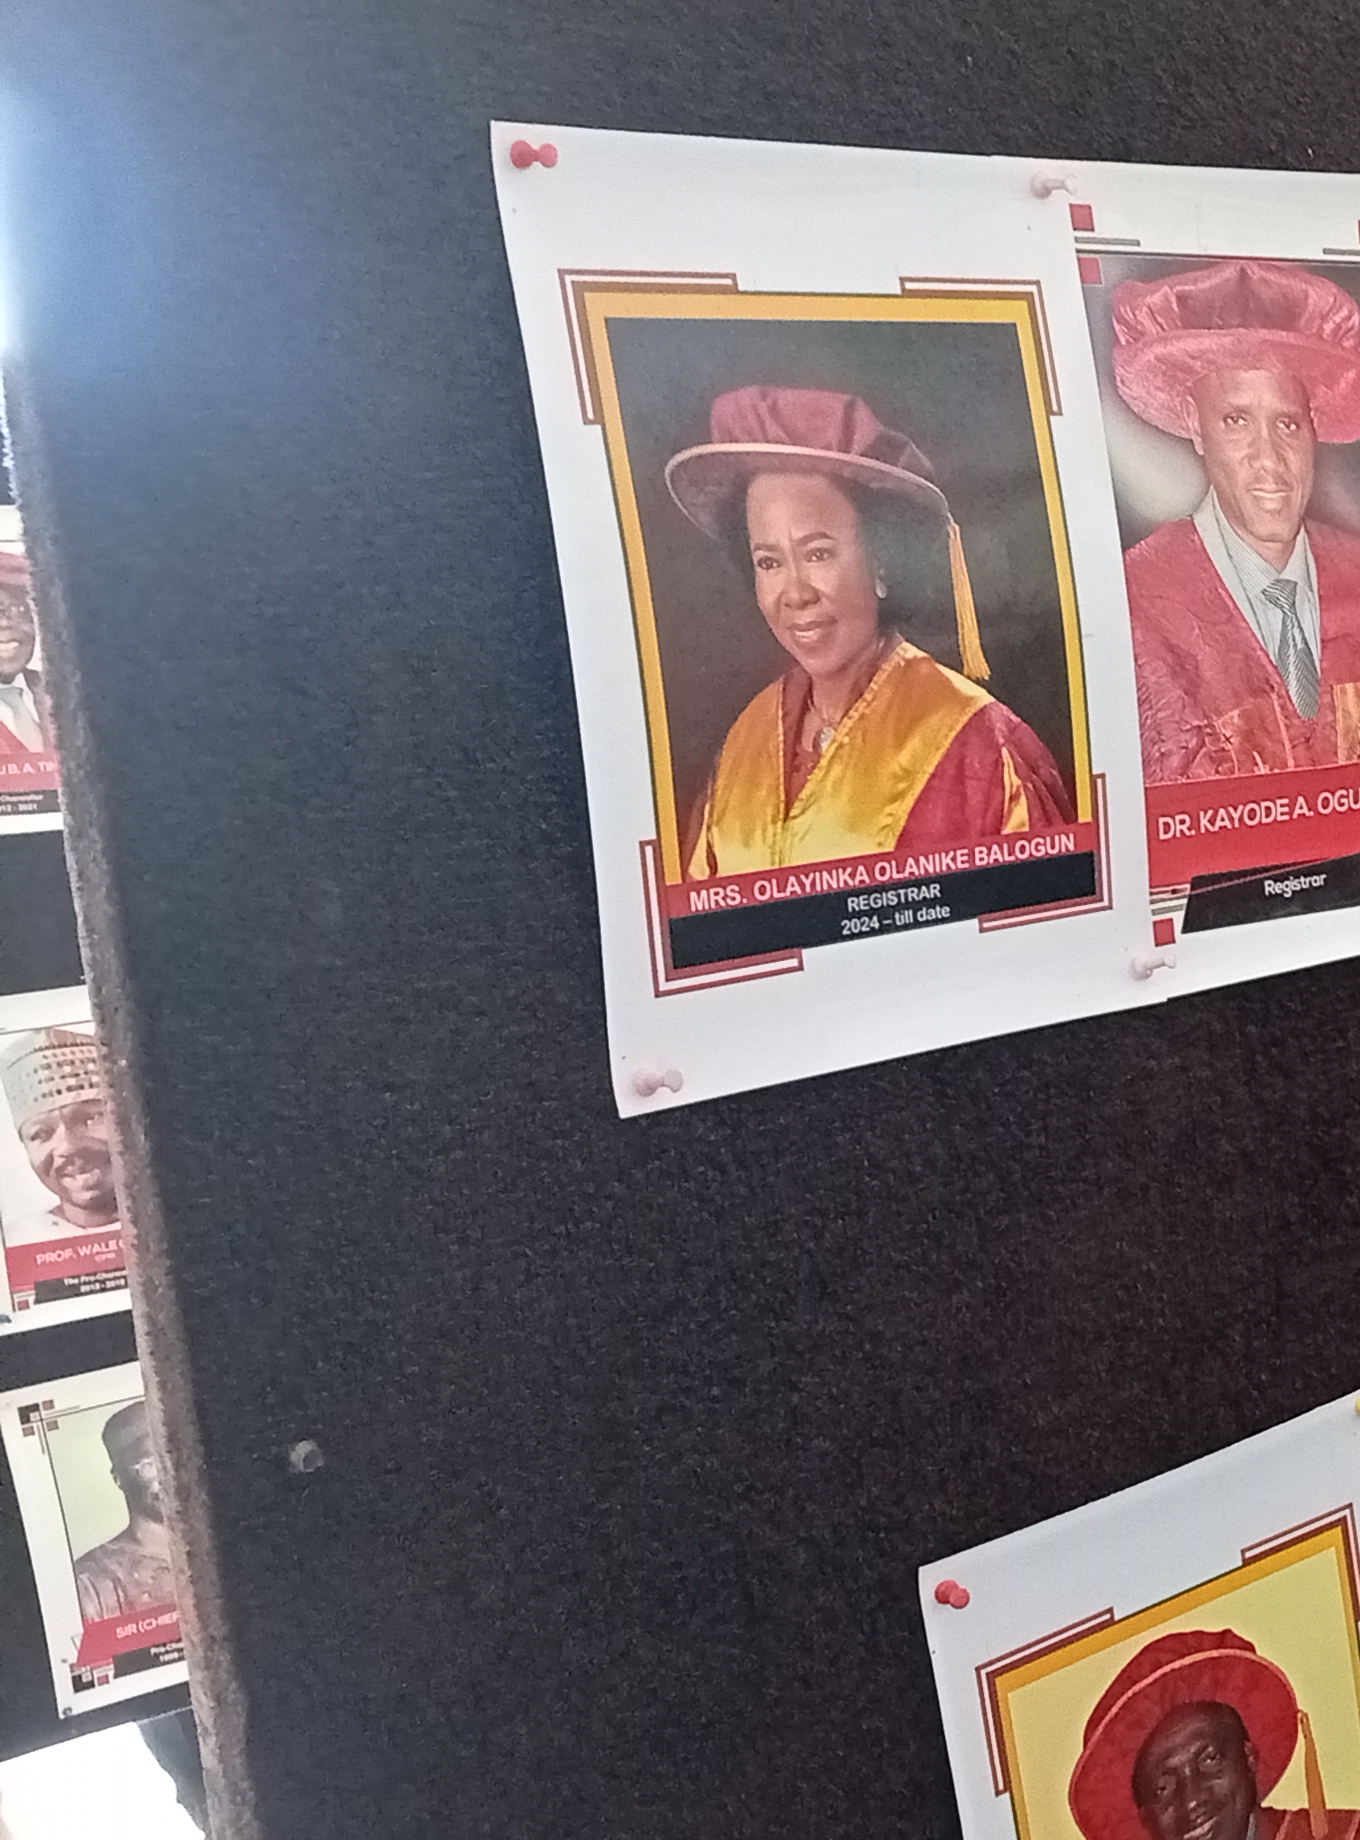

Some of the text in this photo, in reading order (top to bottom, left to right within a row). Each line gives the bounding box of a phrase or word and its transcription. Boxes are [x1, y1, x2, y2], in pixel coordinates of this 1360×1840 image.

[1158, 813, 1196, 840] DR.
[1200, 798, 1290, 832] KAYODE
[1292, 796, 1314, 819] A.
[688, 833, 1076, 913] MRS. OLAYINKA OLANIKE BALOGUN
[1264, 871, 1327, 898] Registrar
[846, 882, 942, 913] REGISTRAR
[840, 914, 880, 936] 2024
[895, 906, 915, 927] till
[917, 903, 952, 923] date
[36, 1248, 77, 1265] PROF.
[78, 1239, 118, 1257] WALE
[116, 1622, 138, 1639] SIR
